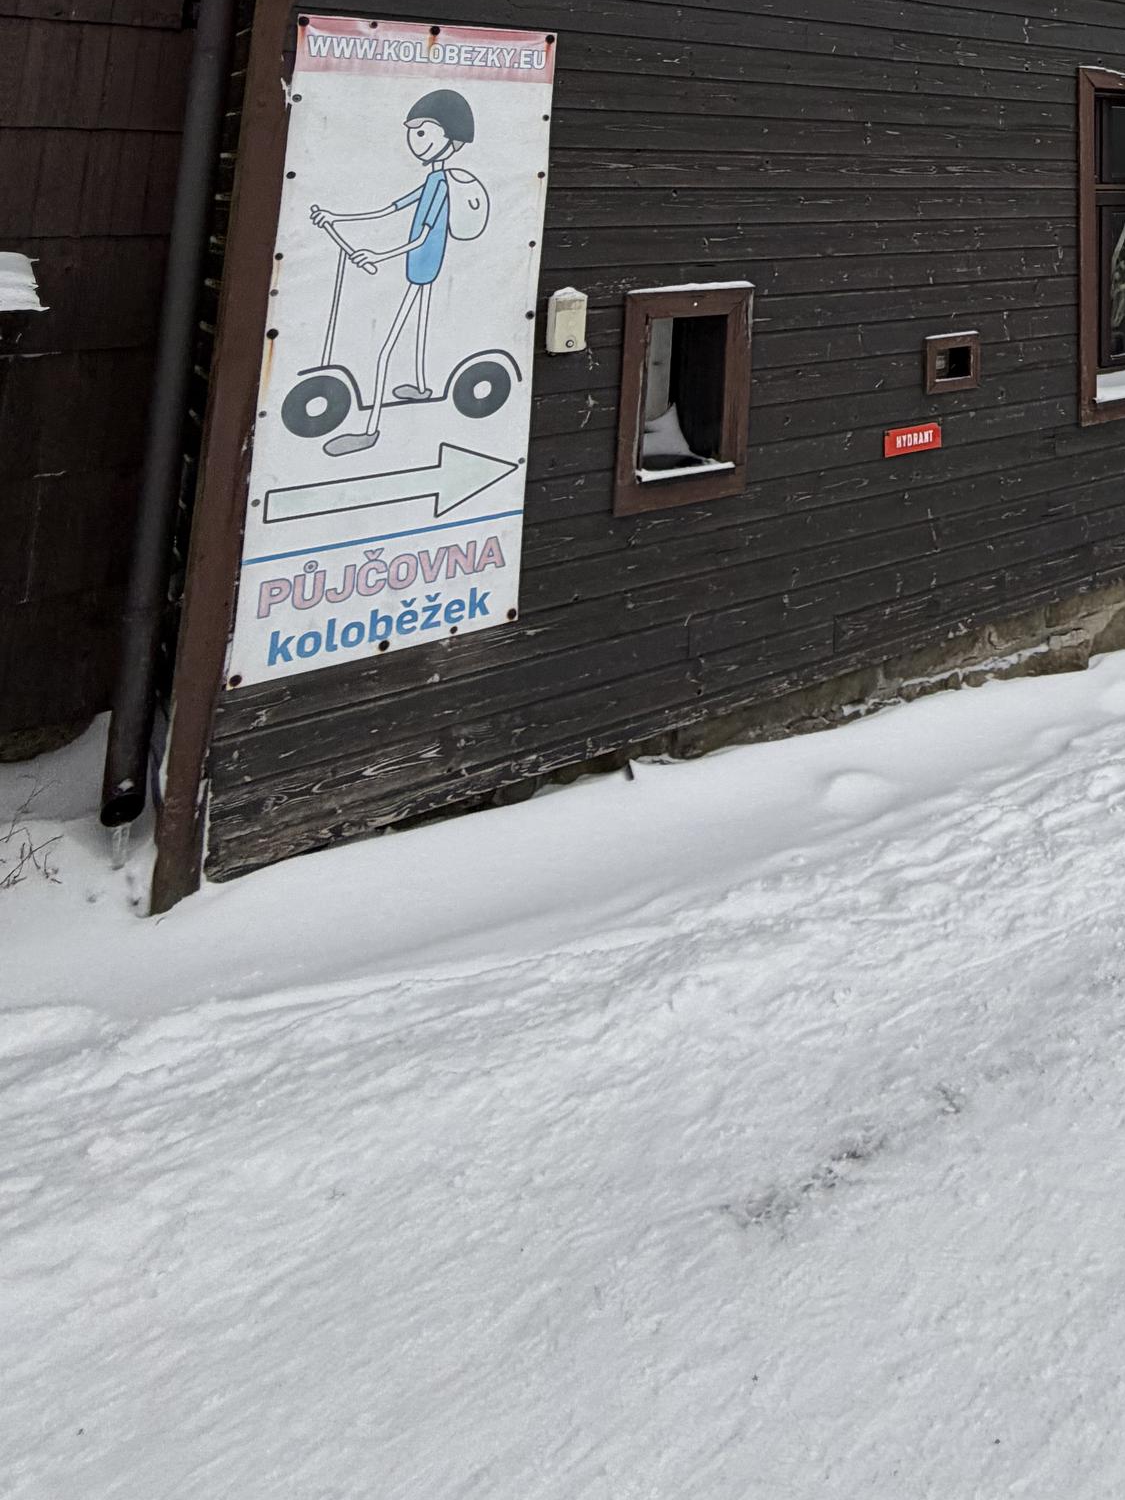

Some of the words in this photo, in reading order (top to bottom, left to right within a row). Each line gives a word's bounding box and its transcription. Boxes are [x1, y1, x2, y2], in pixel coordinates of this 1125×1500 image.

[307, 35, 546, 70] WWW.KOLOBEZKY.EU
[896, 430, 933, 448] HYDRANT
[257, 536, 505, 619] PŮJČOVNA
[267, 587, 491, 666] koloběžek
